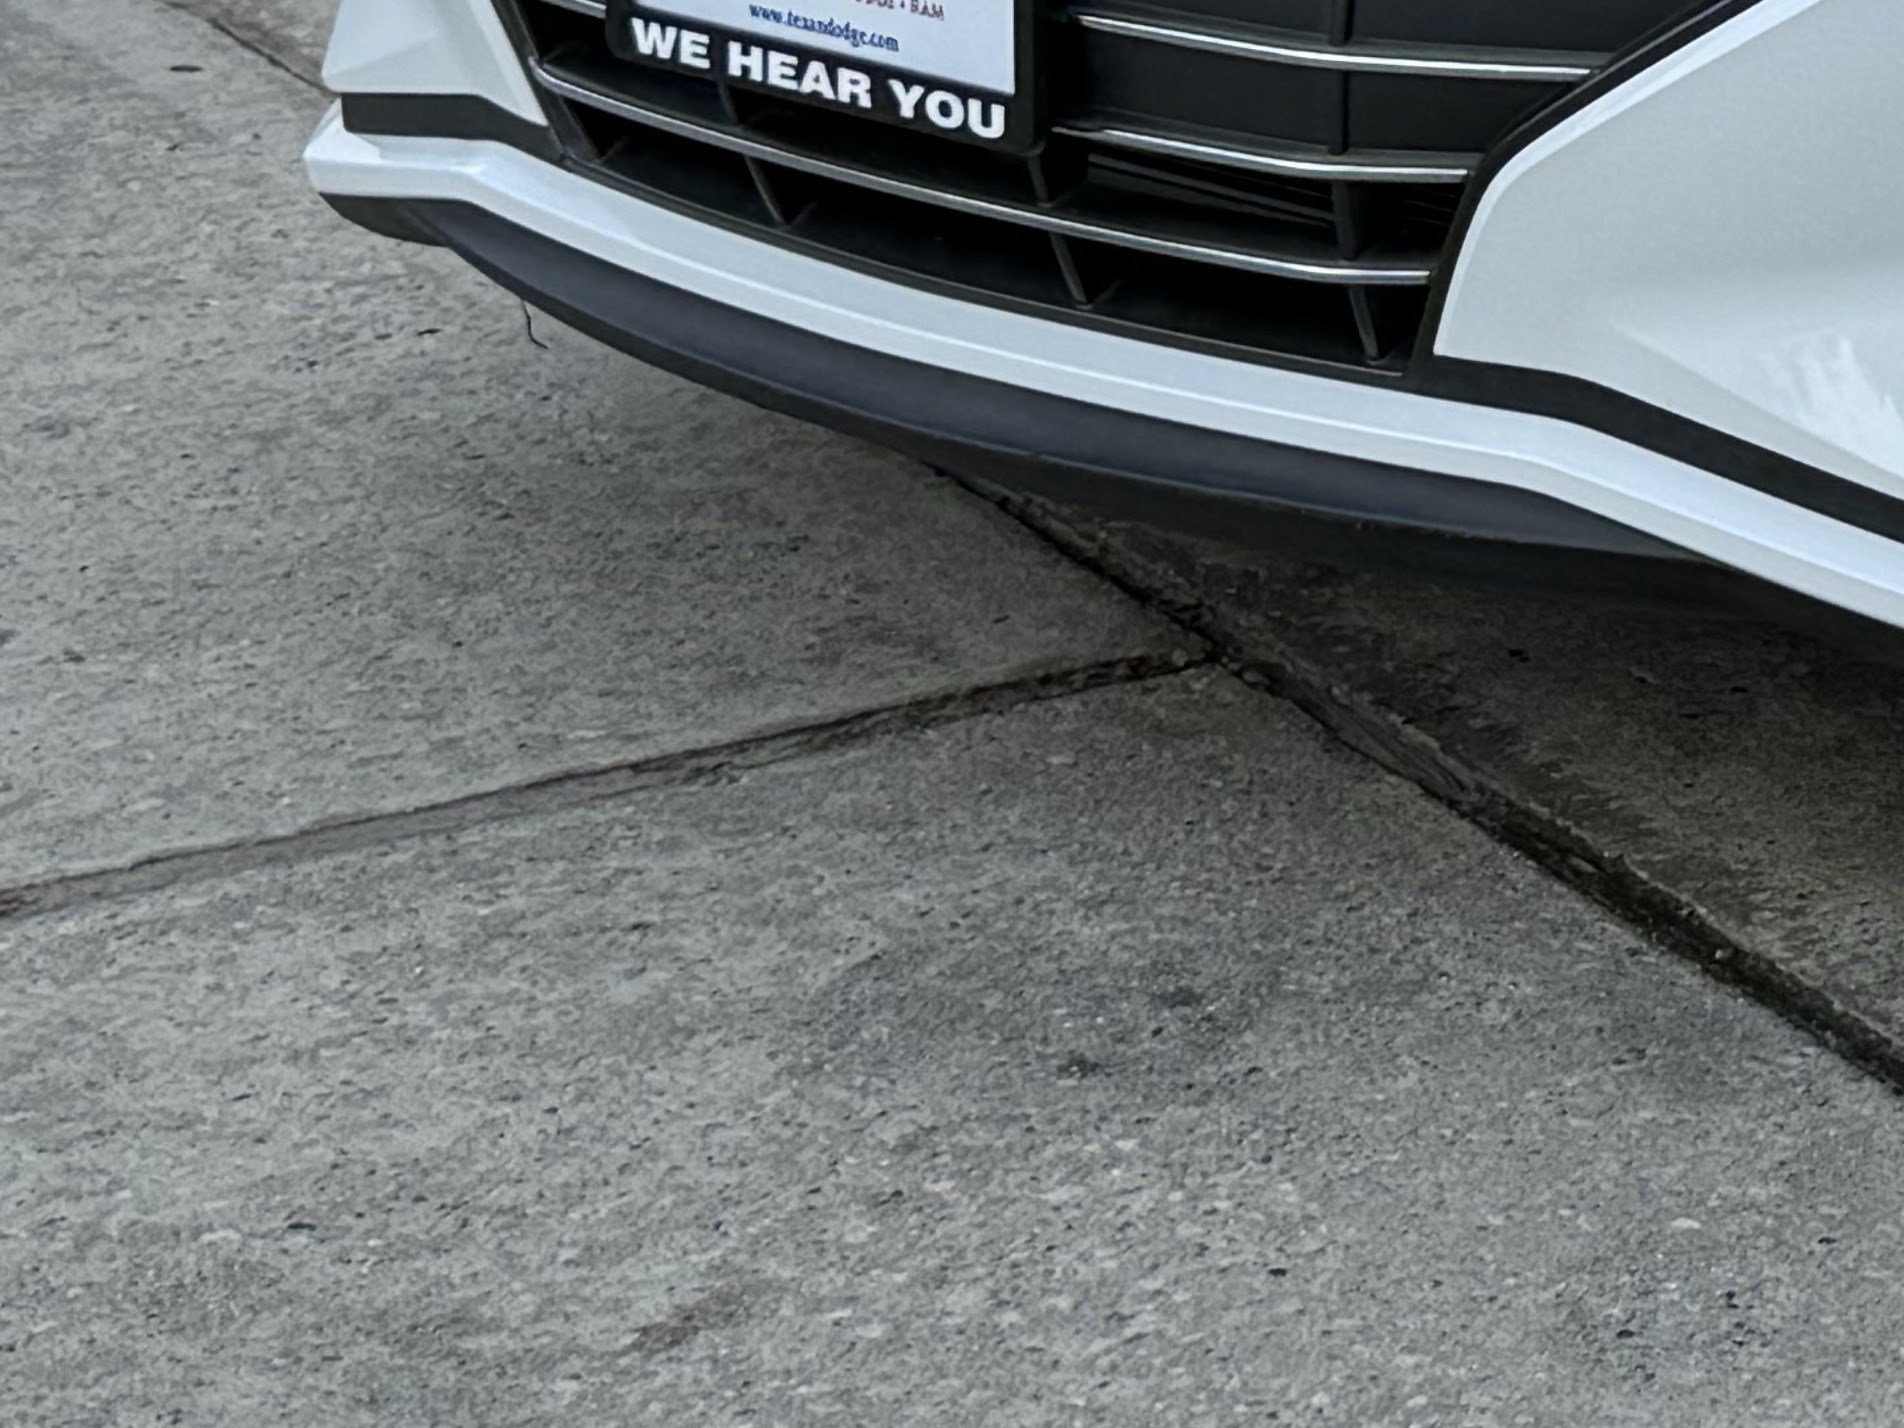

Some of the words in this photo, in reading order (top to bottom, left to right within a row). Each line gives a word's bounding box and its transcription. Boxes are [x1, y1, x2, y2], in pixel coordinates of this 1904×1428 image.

[749, 3, 900, 53] www.texandodge.com
[631, 17, 711, 70] WE
[727, 40, 873, 109] HEAR
[887, 77, 1006, 139] YOU
